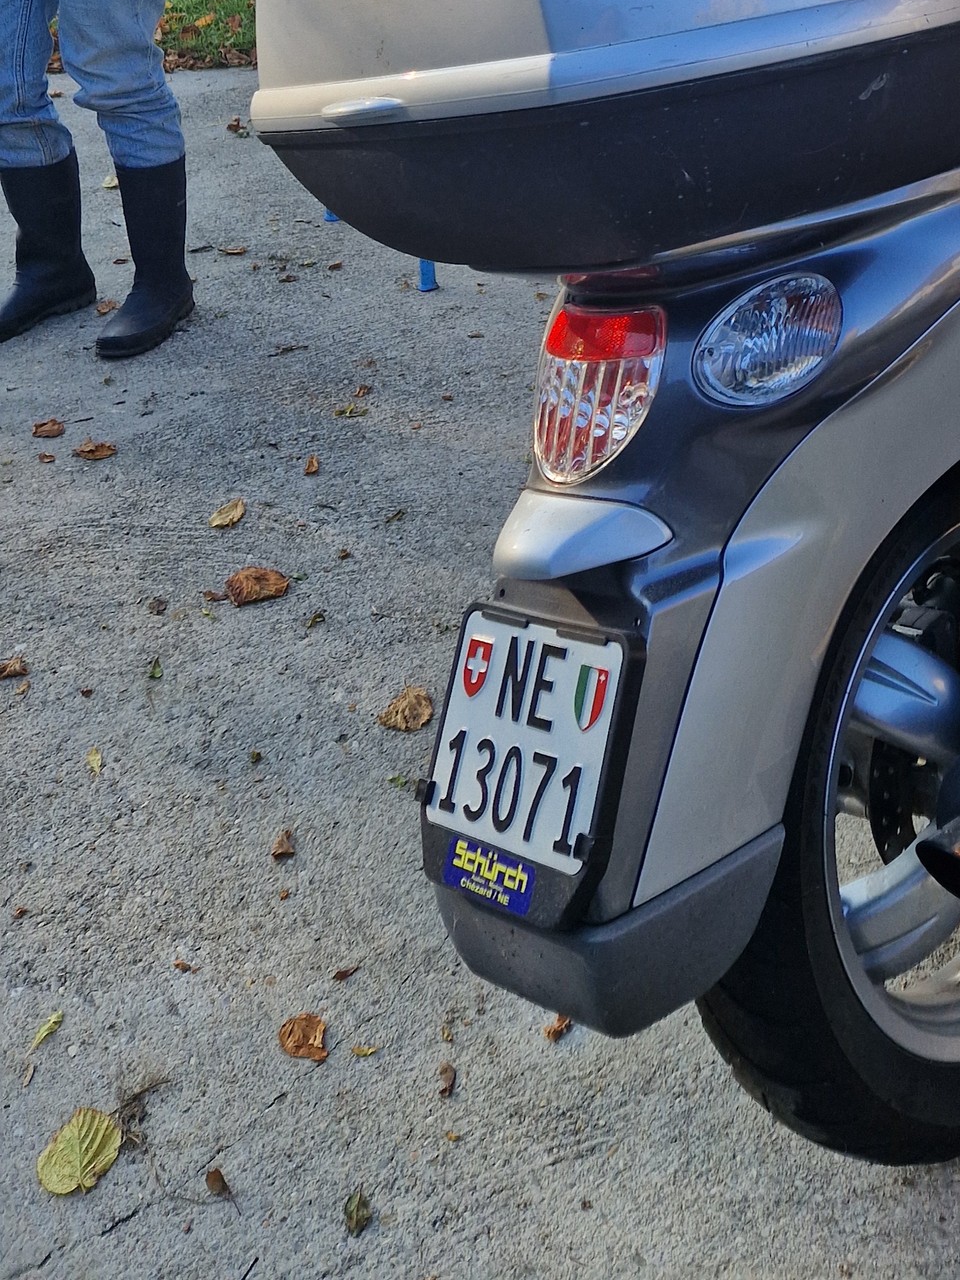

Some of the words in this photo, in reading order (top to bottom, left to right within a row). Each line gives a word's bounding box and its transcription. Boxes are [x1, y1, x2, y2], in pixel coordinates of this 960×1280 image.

[495, 635, 568, 732] NE
[438, 730, 582, 856] 13071
[452, 839, 528, 894] Schürch
[497, 893, 510, 906] NE
